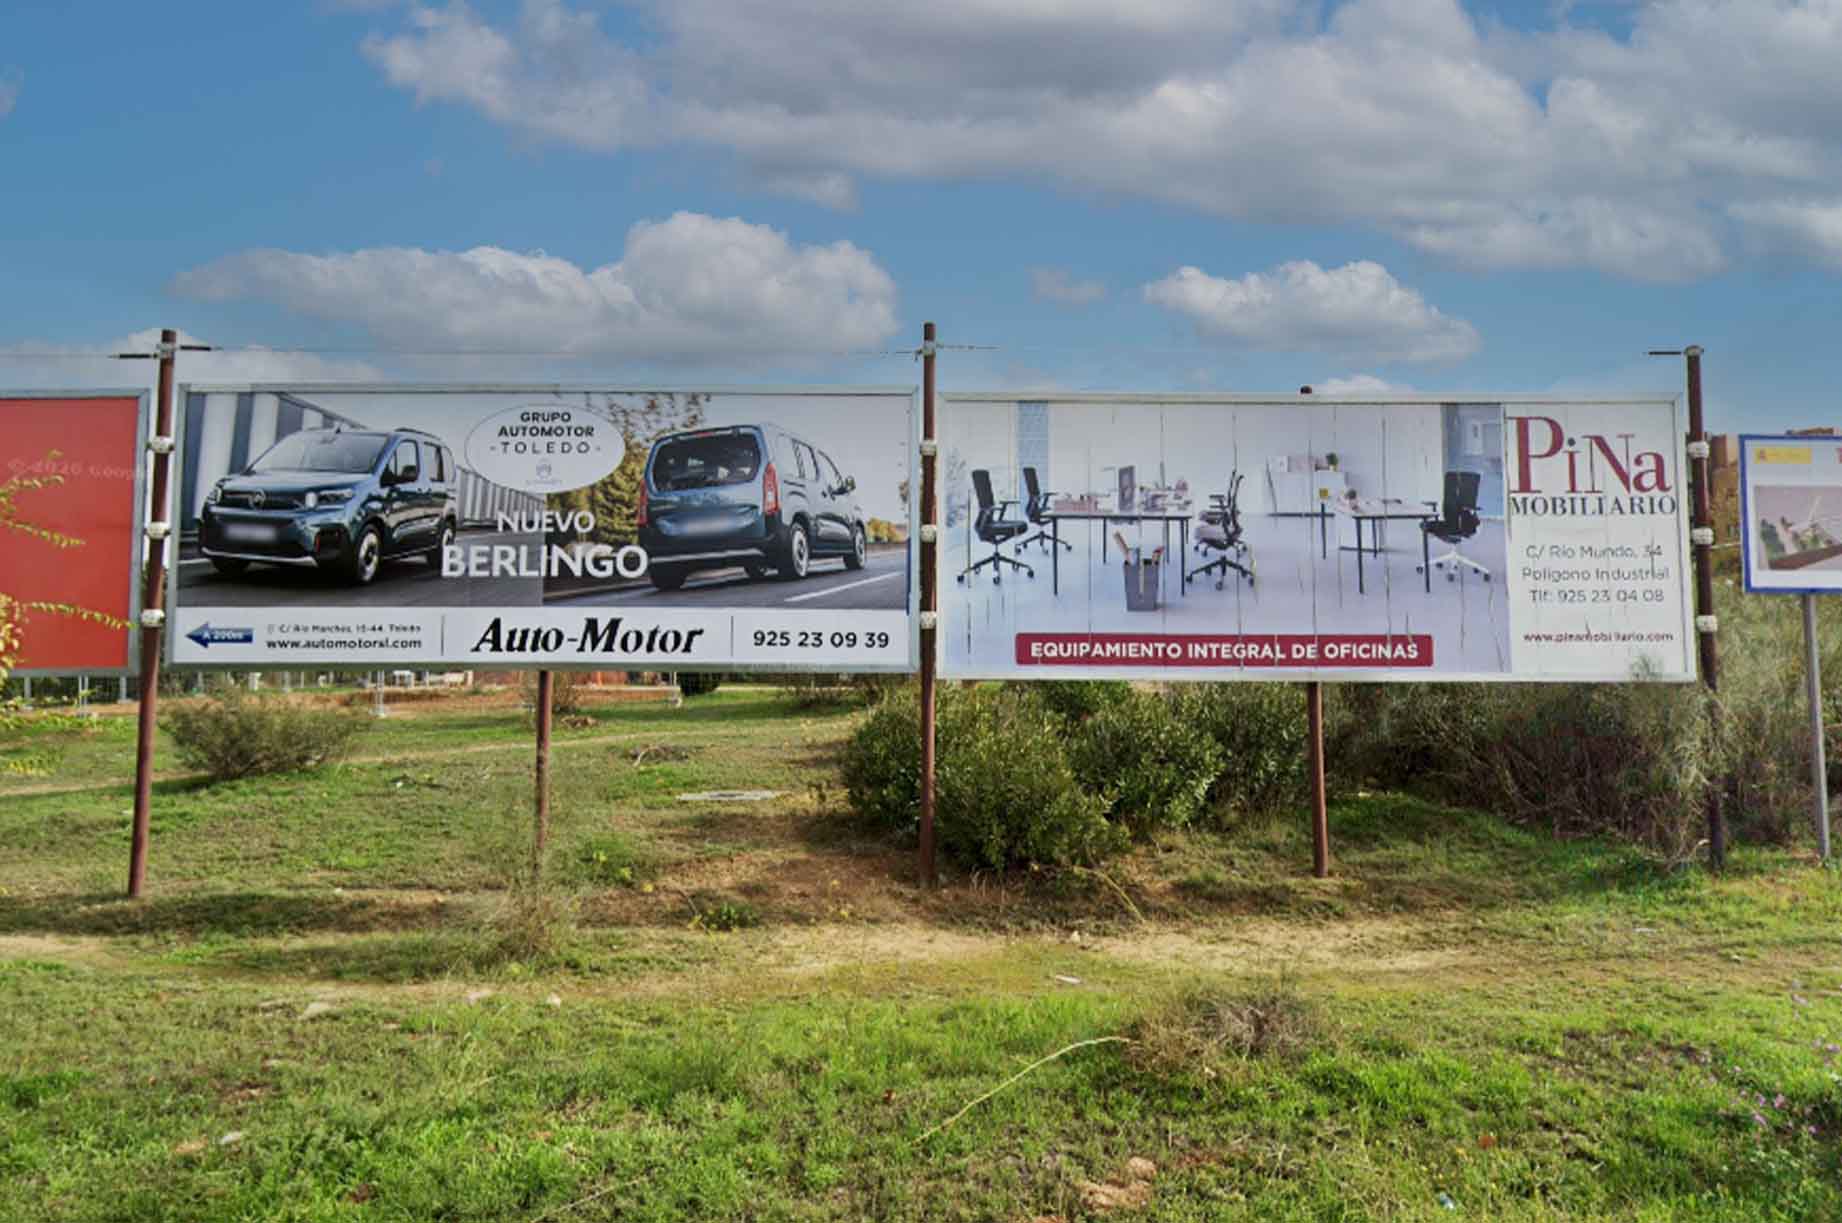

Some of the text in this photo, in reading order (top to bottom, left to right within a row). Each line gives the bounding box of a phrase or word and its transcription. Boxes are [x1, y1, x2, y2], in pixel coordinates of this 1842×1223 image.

[520, 411, 572, 423] GRUPO
[498, 426, 595, 438] AUTOMOTOR
[1510, 495, 1677, 516] MOBILIARIO
[497, 511, 595, 533] NUEVO
[441, 544, 649, 578] BERLINGO
[1525, 545, 1545, 560] C/
[1596, 566, 1669, 582] Industrial
[1557, 589, 1587, 603] 925
[1591, 589, 1611, 603] 23
[1616, 589, 1638, 603] 04
[1642, 589, 1665, 603] 08
[470, 617, 704, 653] Auto-Motor
[753, 630, 889, 648] 925 23 09 39
[1030, 641, 1419, 660] EQUIPAMIENTO INTEGRAL DE OFICINAS
